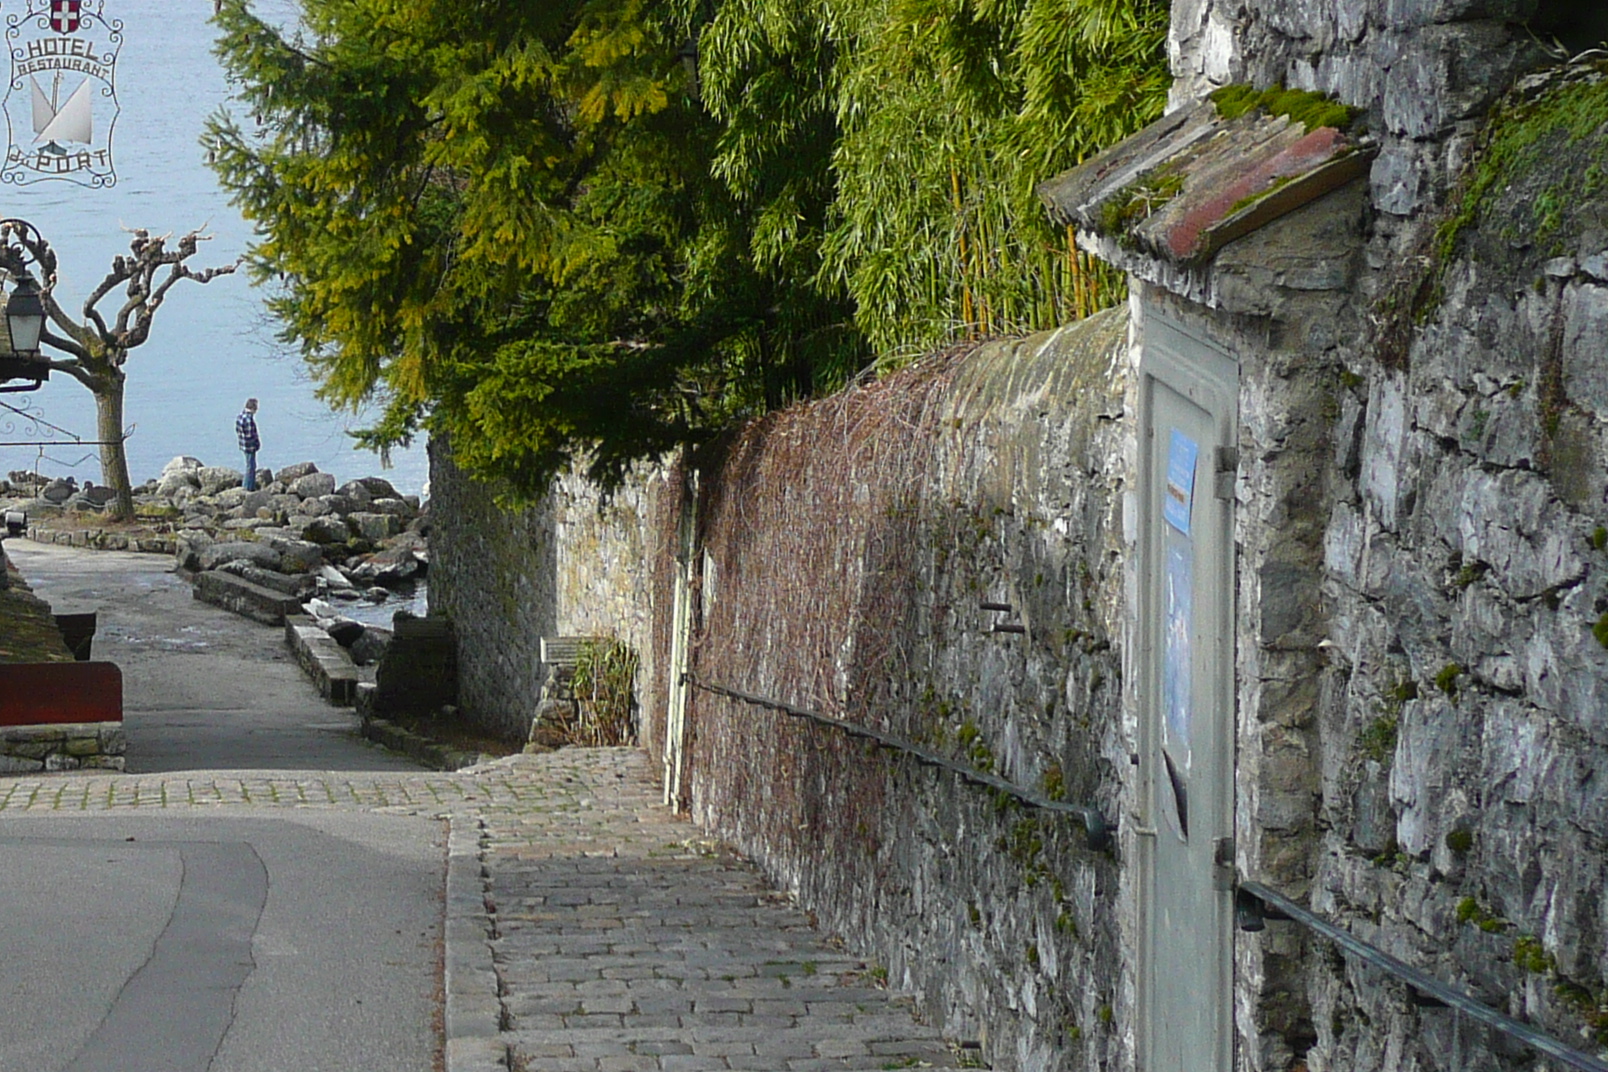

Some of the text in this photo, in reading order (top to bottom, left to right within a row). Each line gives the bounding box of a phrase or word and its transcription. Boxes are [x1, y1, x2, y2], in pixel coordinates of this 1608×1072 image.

[27, 37, 99, 61] HOTEL
[17, 58, 110, 79] RESTAURANT
[36, 149, 107, 173] PORT
